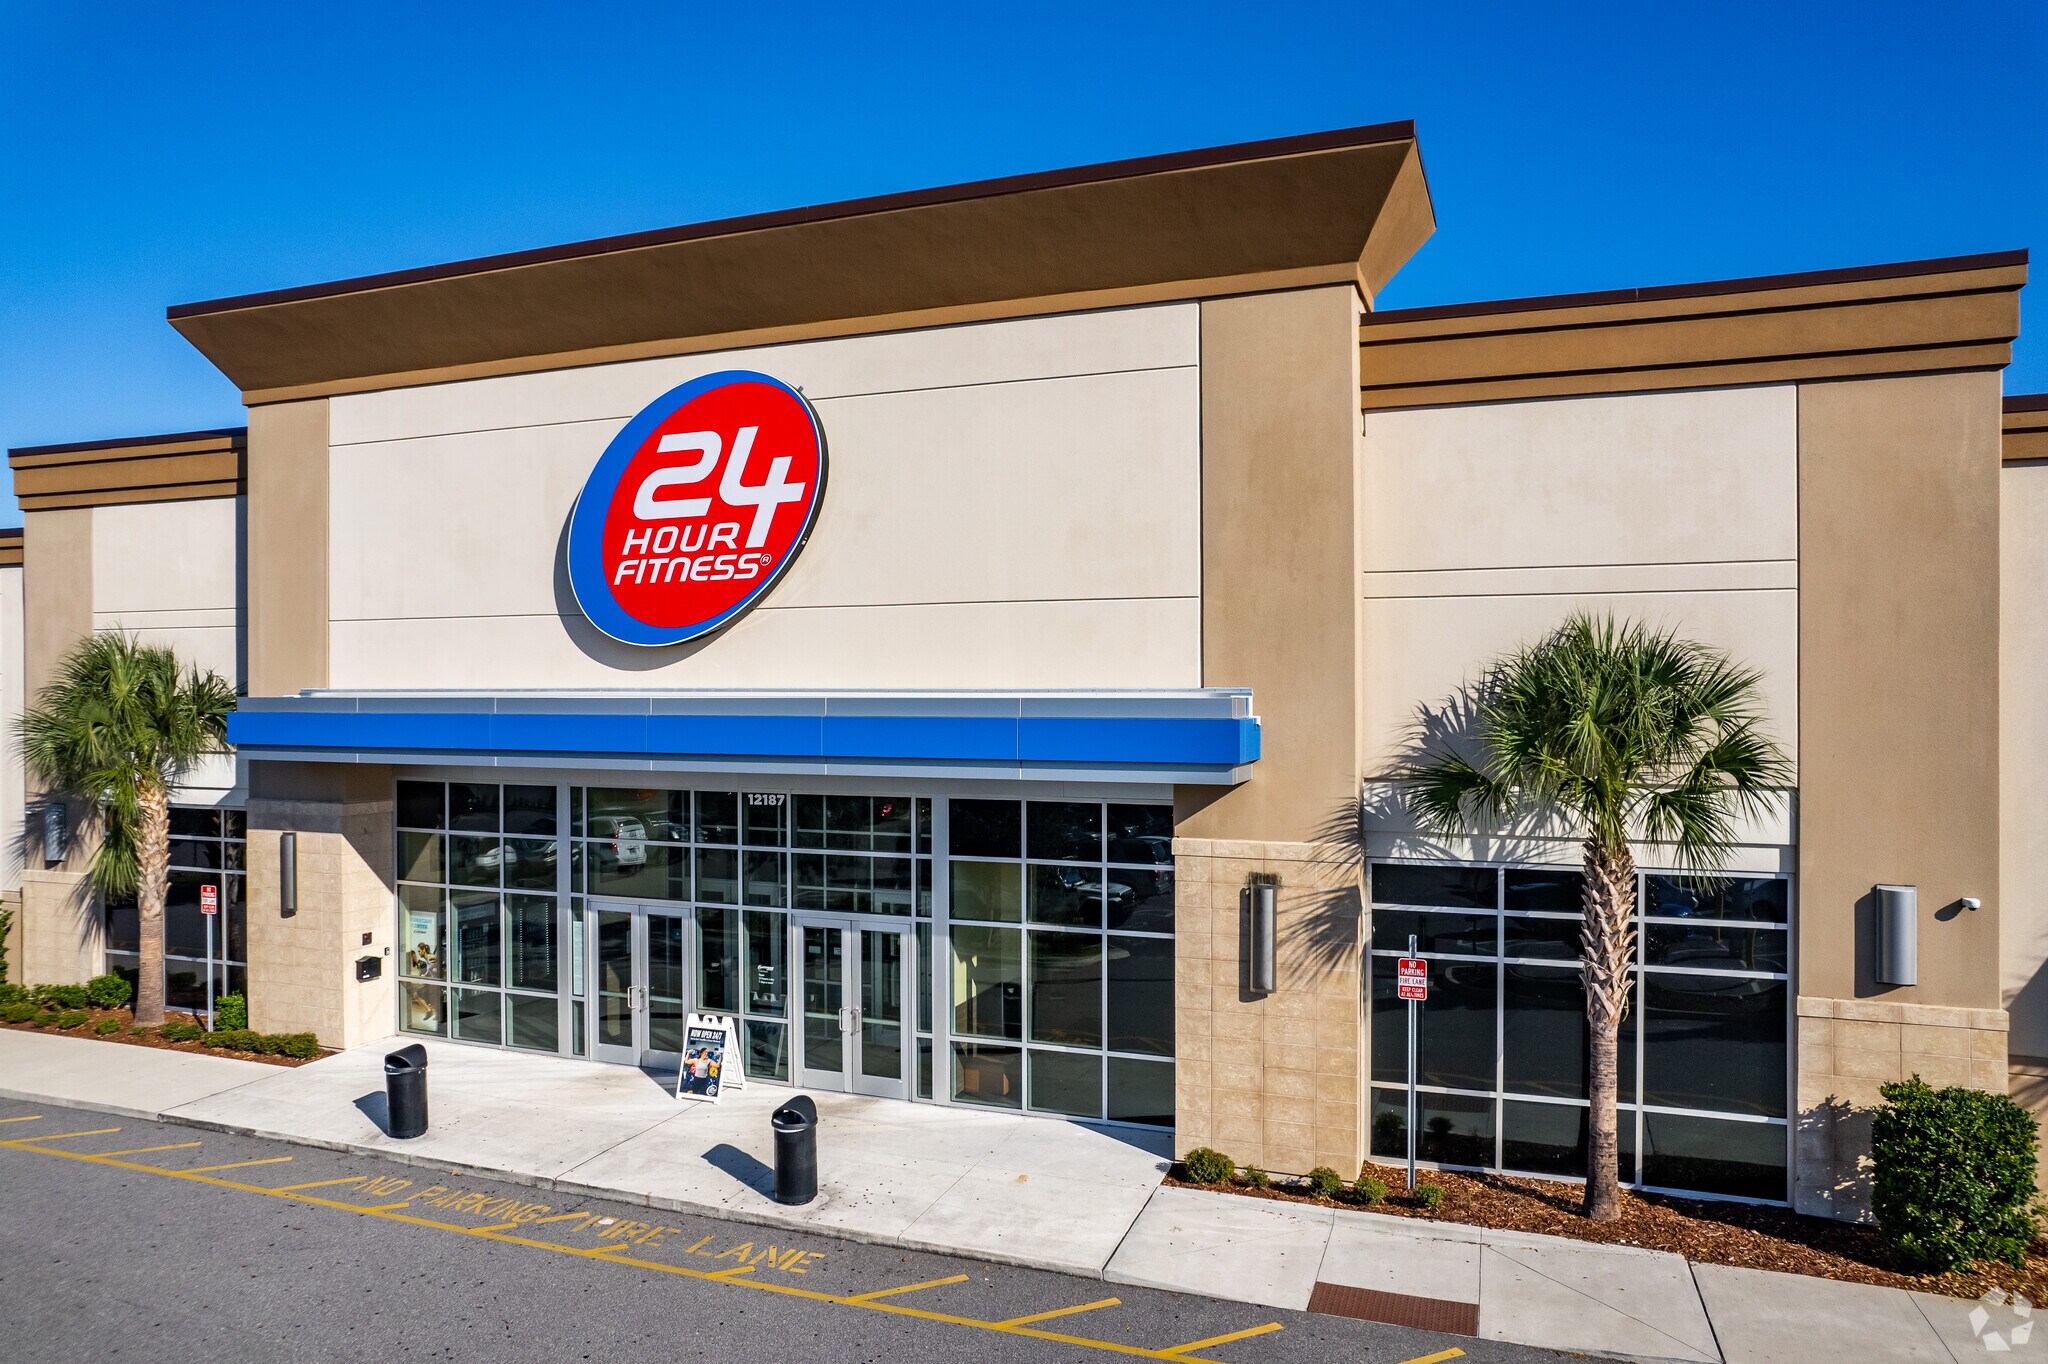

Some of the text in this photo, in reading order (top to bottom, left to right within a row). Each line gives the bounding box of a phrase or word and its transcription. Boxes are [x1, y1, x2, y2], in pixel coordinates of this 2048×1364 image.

[633, 426, 806, 548] 24
[622, 522, 740, 555] HOUR
[747, 793, 785, 806] 12187
[1401, 968, 1424, 976] PARKING
[690, 1029, 722, 1040] NOW OPEN 24/7
[353, 1175, 826, 1274] NO PARKING FIRE LANE
